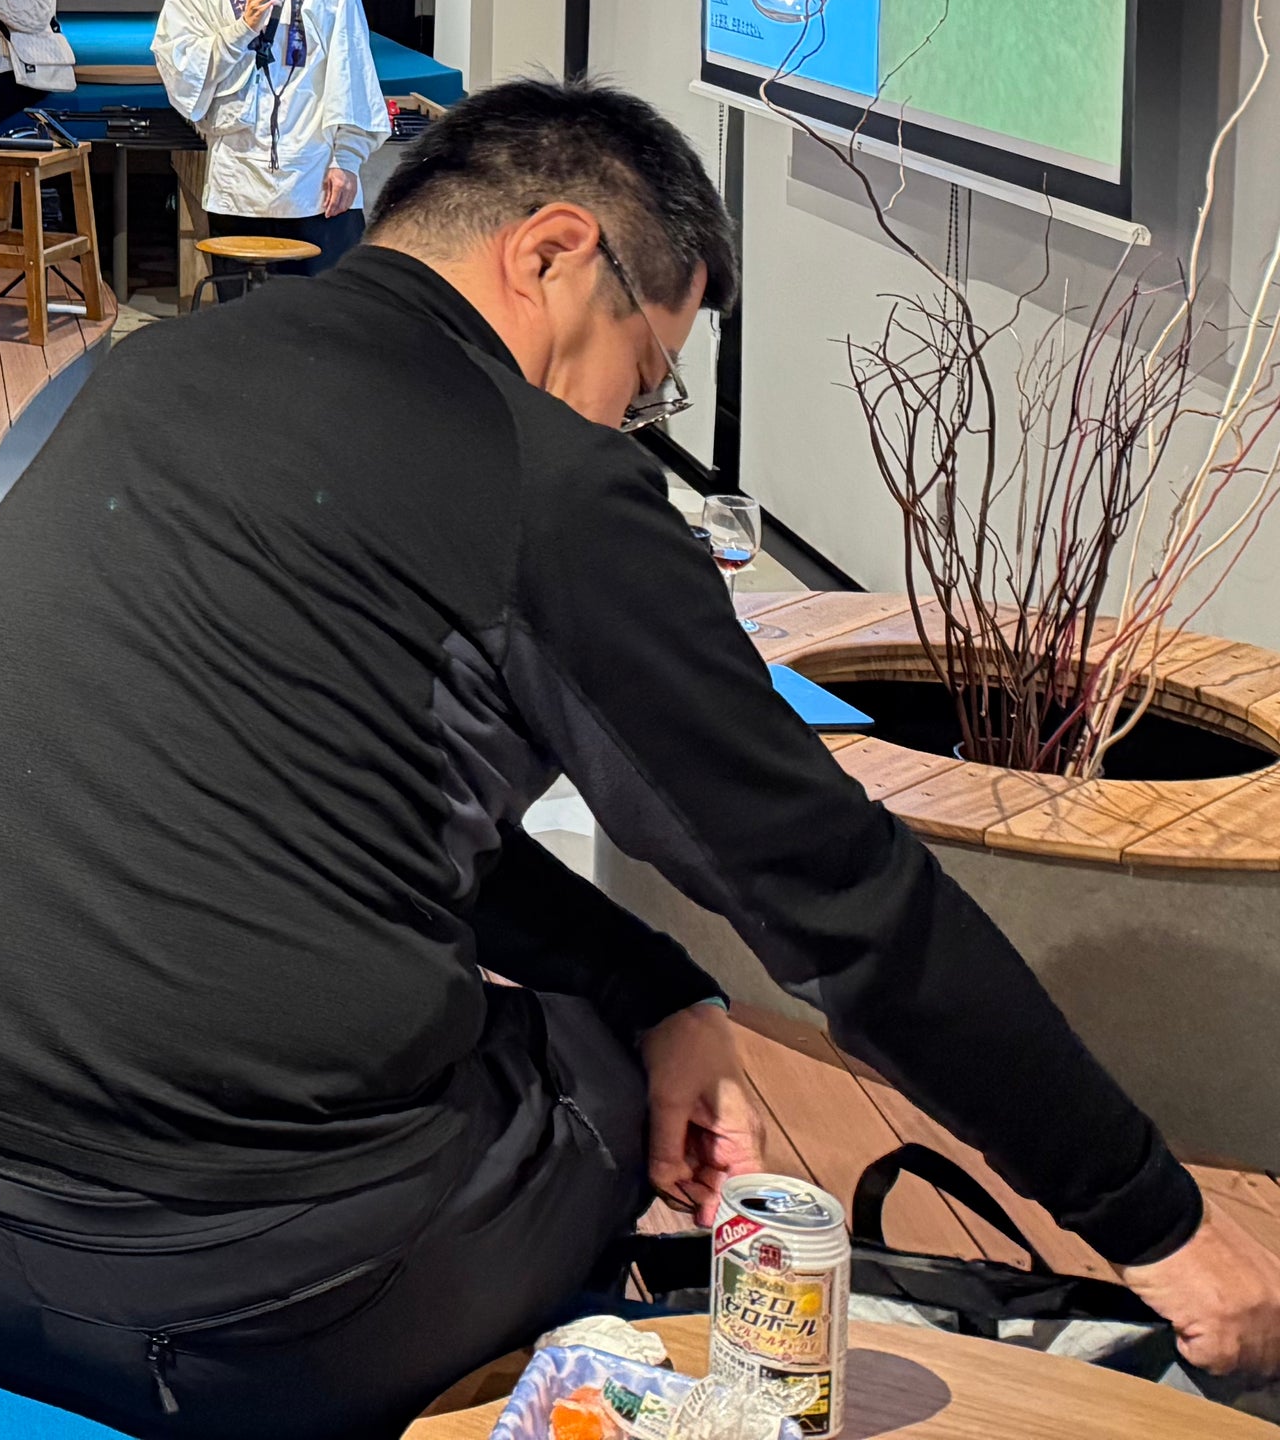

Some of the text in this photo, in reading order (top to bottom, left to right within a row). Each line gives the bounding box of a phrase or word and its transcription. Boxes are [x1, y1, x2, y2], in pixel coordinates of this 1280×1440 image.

[722, 1294, 818, 1336] ゼロボール
[745, 1288, 795, 1316] 辛口
